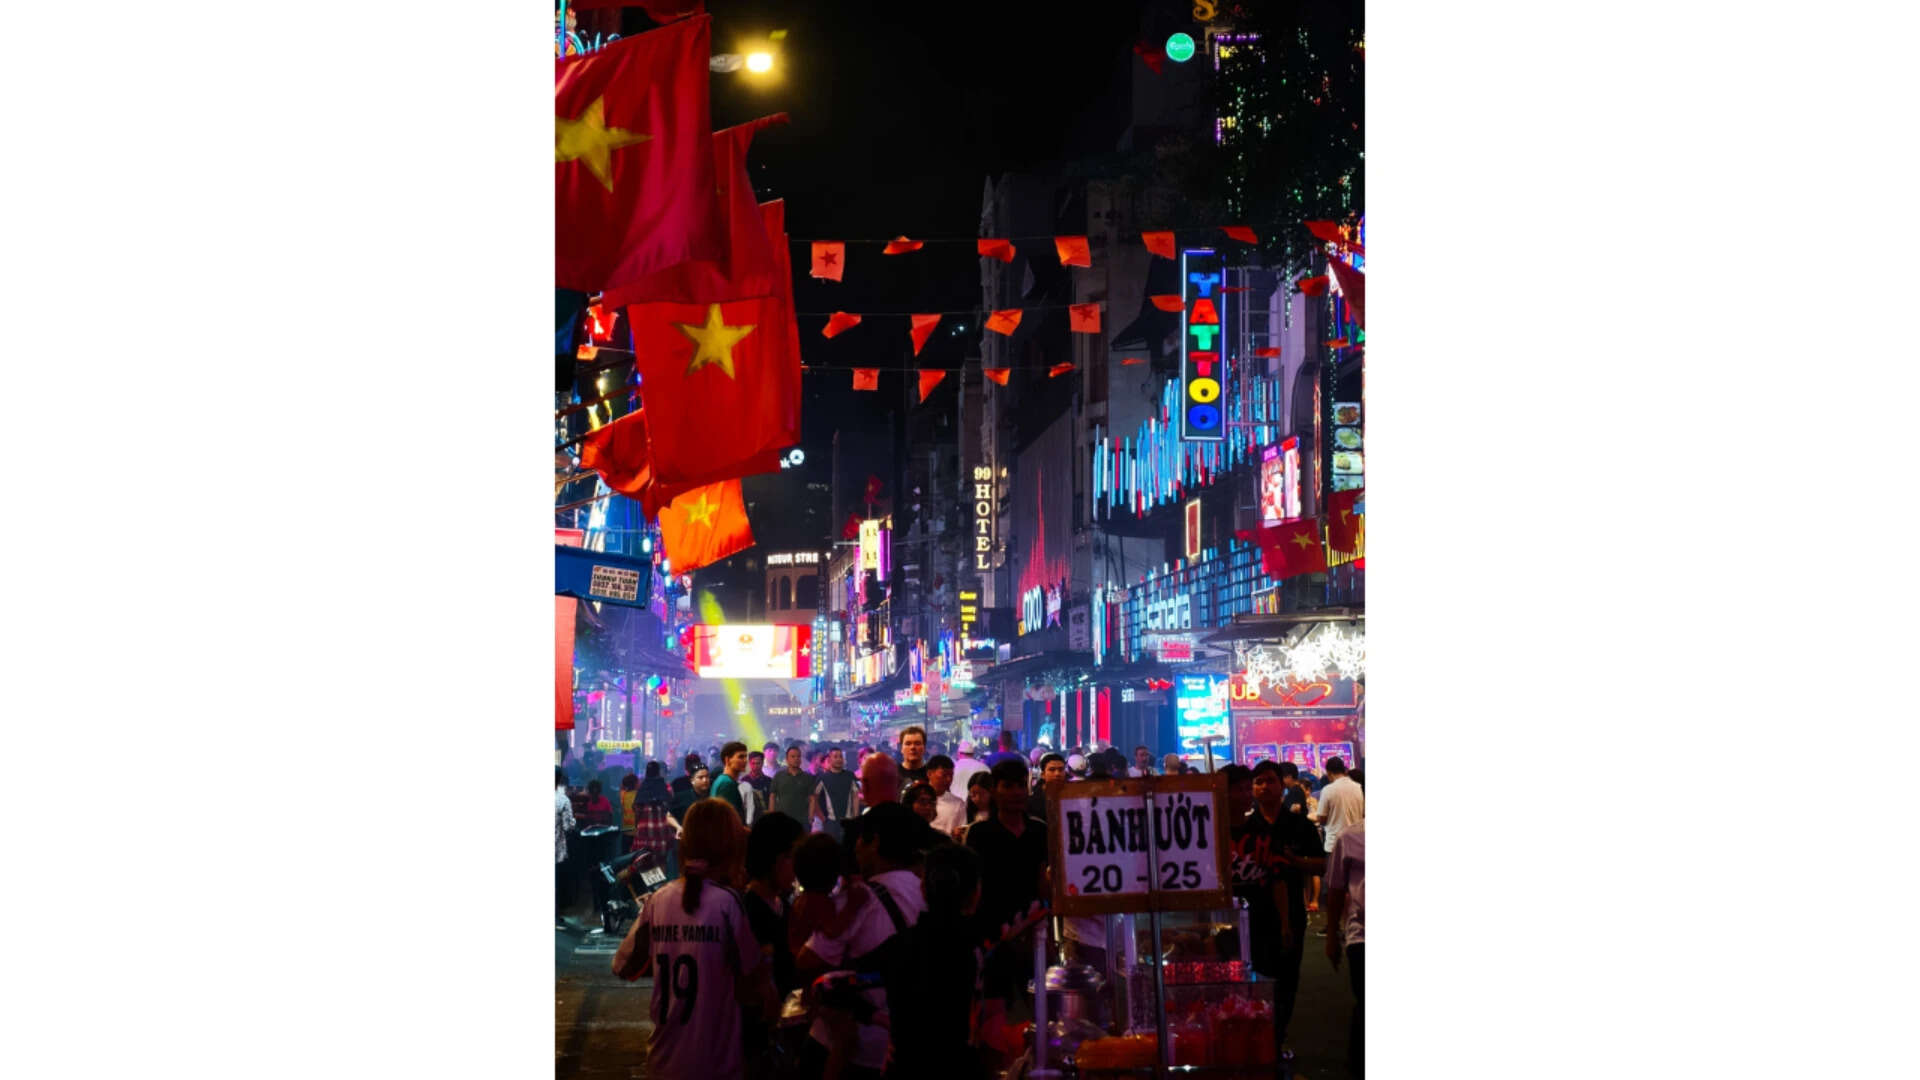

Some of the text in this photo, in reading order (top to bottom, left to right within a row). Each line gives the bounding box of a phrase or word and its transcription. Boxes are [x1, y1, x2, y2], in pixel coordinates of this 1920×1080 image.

[1188, 272, 1220, 430] TATTOO
[974, 466, 991, 480] 99
[975, 484, 991, 569] HOTEL
[1067, 793, 1210, 855] BÁNH ƯỚT
[1082, 864, 1123, 893] 20
[1161, 861, 1202, 889] 25
[656, 954, 698, 1026] 19
